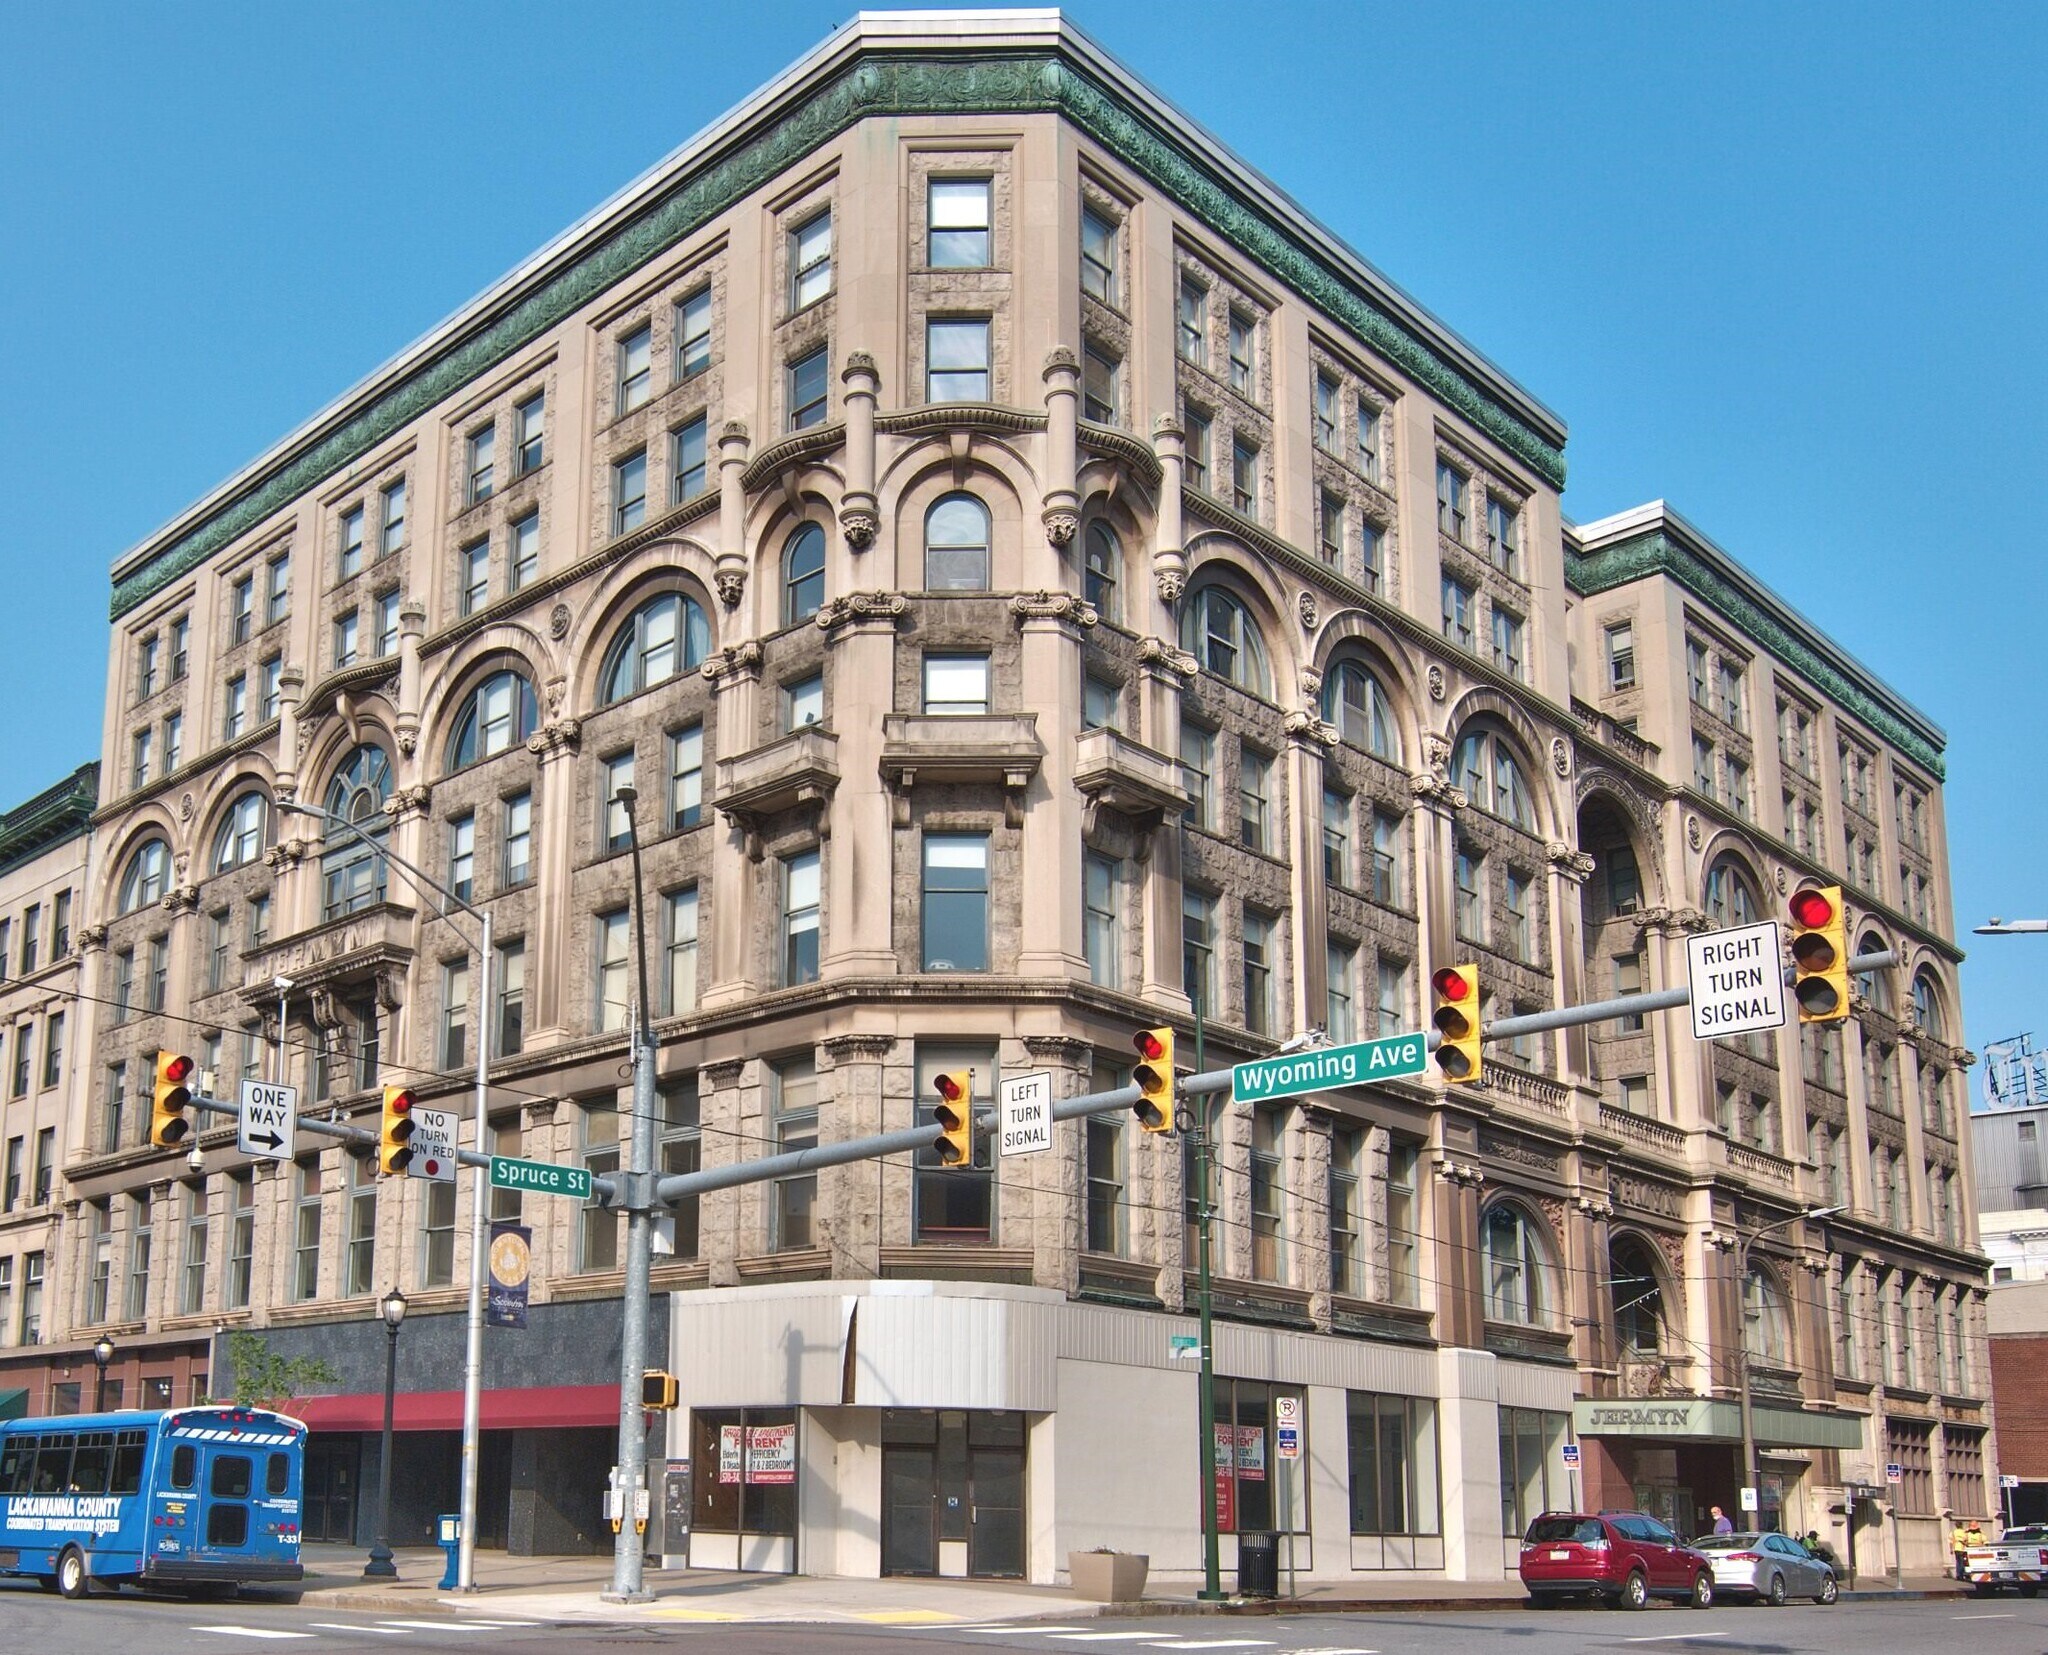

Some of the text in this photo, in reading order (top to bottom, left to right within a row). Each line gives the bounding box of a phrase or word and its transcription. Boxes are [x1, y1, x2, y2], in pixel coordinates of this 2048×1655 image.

[1703, 936, 1762, 965] RIGHT
[1708, 967, 1762, 993] TURN
[1701, 996, 1776, 1025] SIGNAL
[1241, 1043, 1417, 1093] Wyoming Ave
[252, 1087, 287, 1107] ONE
[1011, 1083, 1039, 1102] LEFT
[249, 1107, 287, 1127] WAY
[424, 1112, 445, 1127] NO
[1010, 1105, 1041, 1124] TURN
[419, 1128, 449, 1143] TURN
[1004, 1127, 1047, 1147] SIGNAL
[411, 1143, 455, 1159] ON RED
[498, 1161, 585, 1190] Spruce St
[1590, 1408, 1690, 1426] JERMYN
[754, 1437, 783, 1448] RENT
[7, 1497, 122, 1518] LACKAWANNA COUNTY
[45, 1519, 95, 1532] TRANSPORTATION
[95, 1519, 120, 1533] SYSTEM
[277, 1535, 297, 1544] T-33
